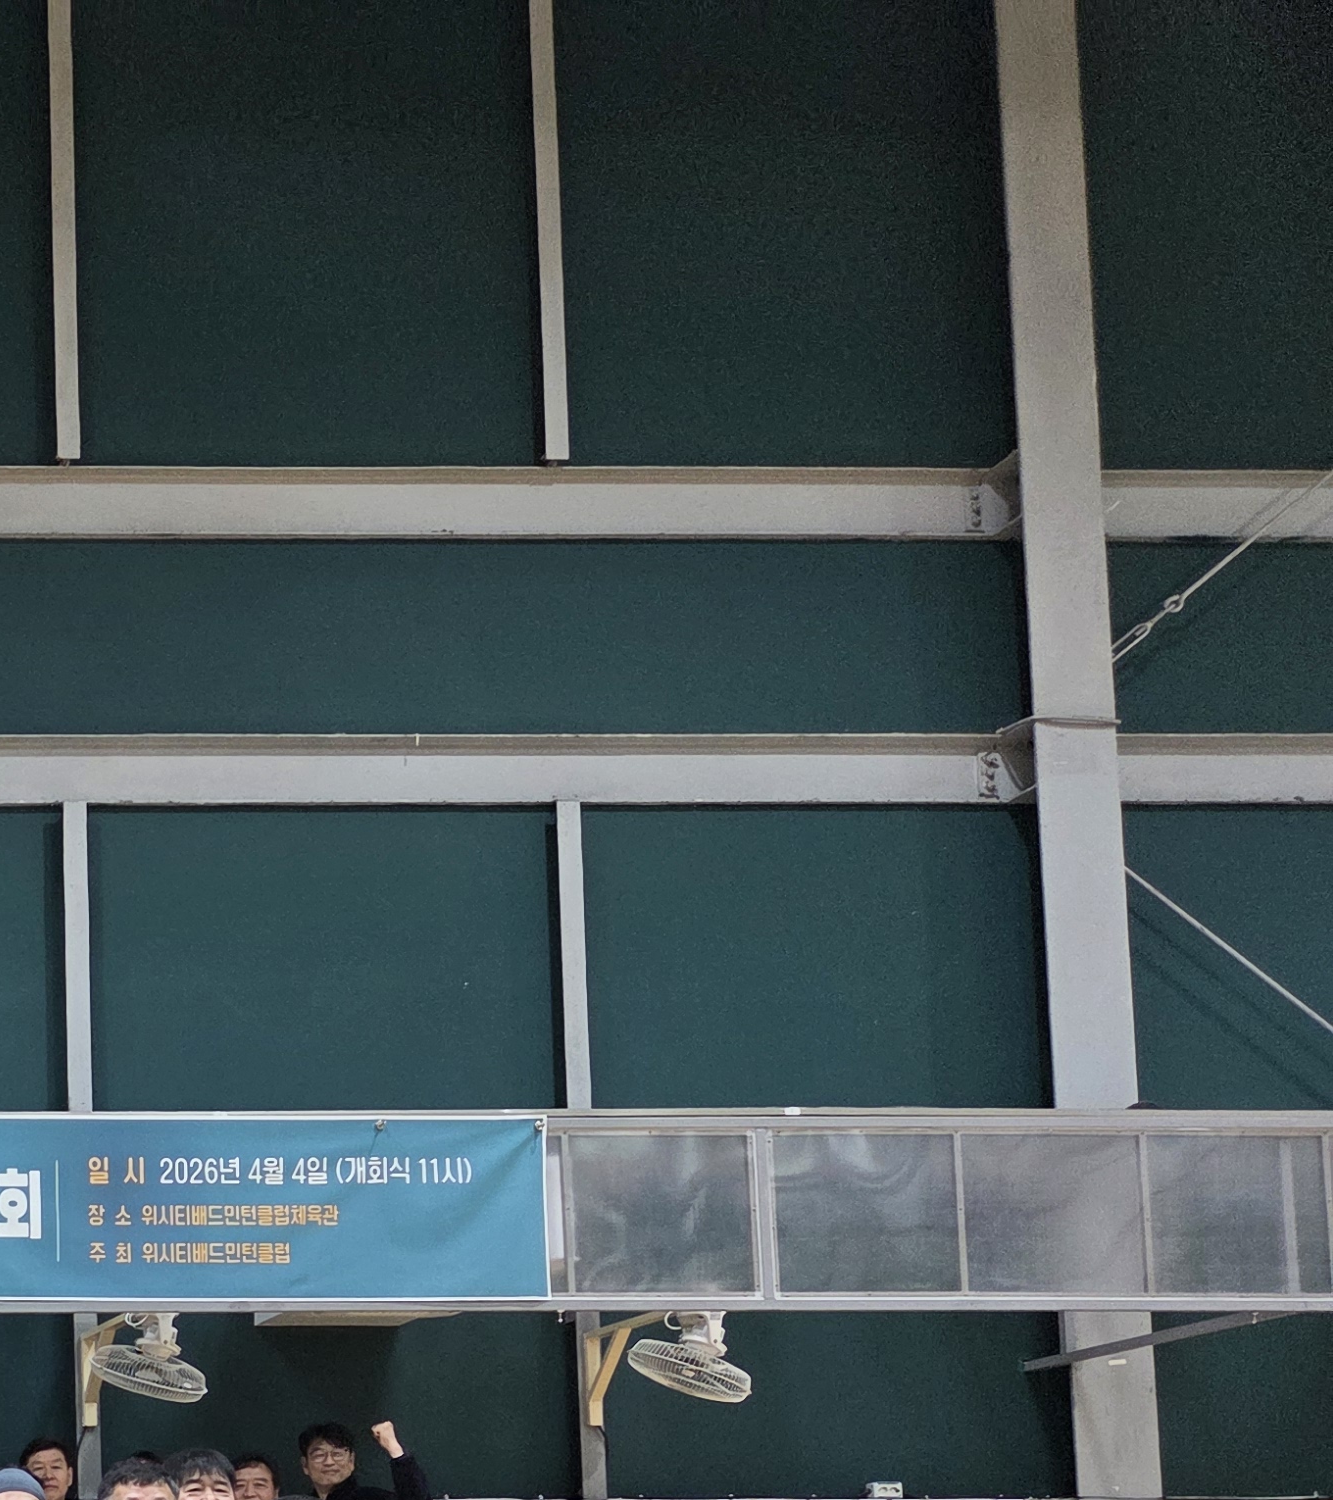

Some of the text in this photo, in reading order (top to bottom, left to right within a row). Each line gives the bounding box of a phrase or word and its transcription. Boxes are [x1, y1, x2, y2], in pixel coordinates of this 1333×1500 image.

[159, 1156, 241, 1185] 2026년
[248, 1156, 284, 1185] 4월
[291, 1156, 328, 1185] 4일
[335, 1156, 411, 1185] (개회식
[417, 1156, 473, 1185] 11시)
[141, 1204, 340, 1227] 위시티배드민턴클럽체육관
[141, 1242, 291, 1264] 위시티배드민턴클럽
